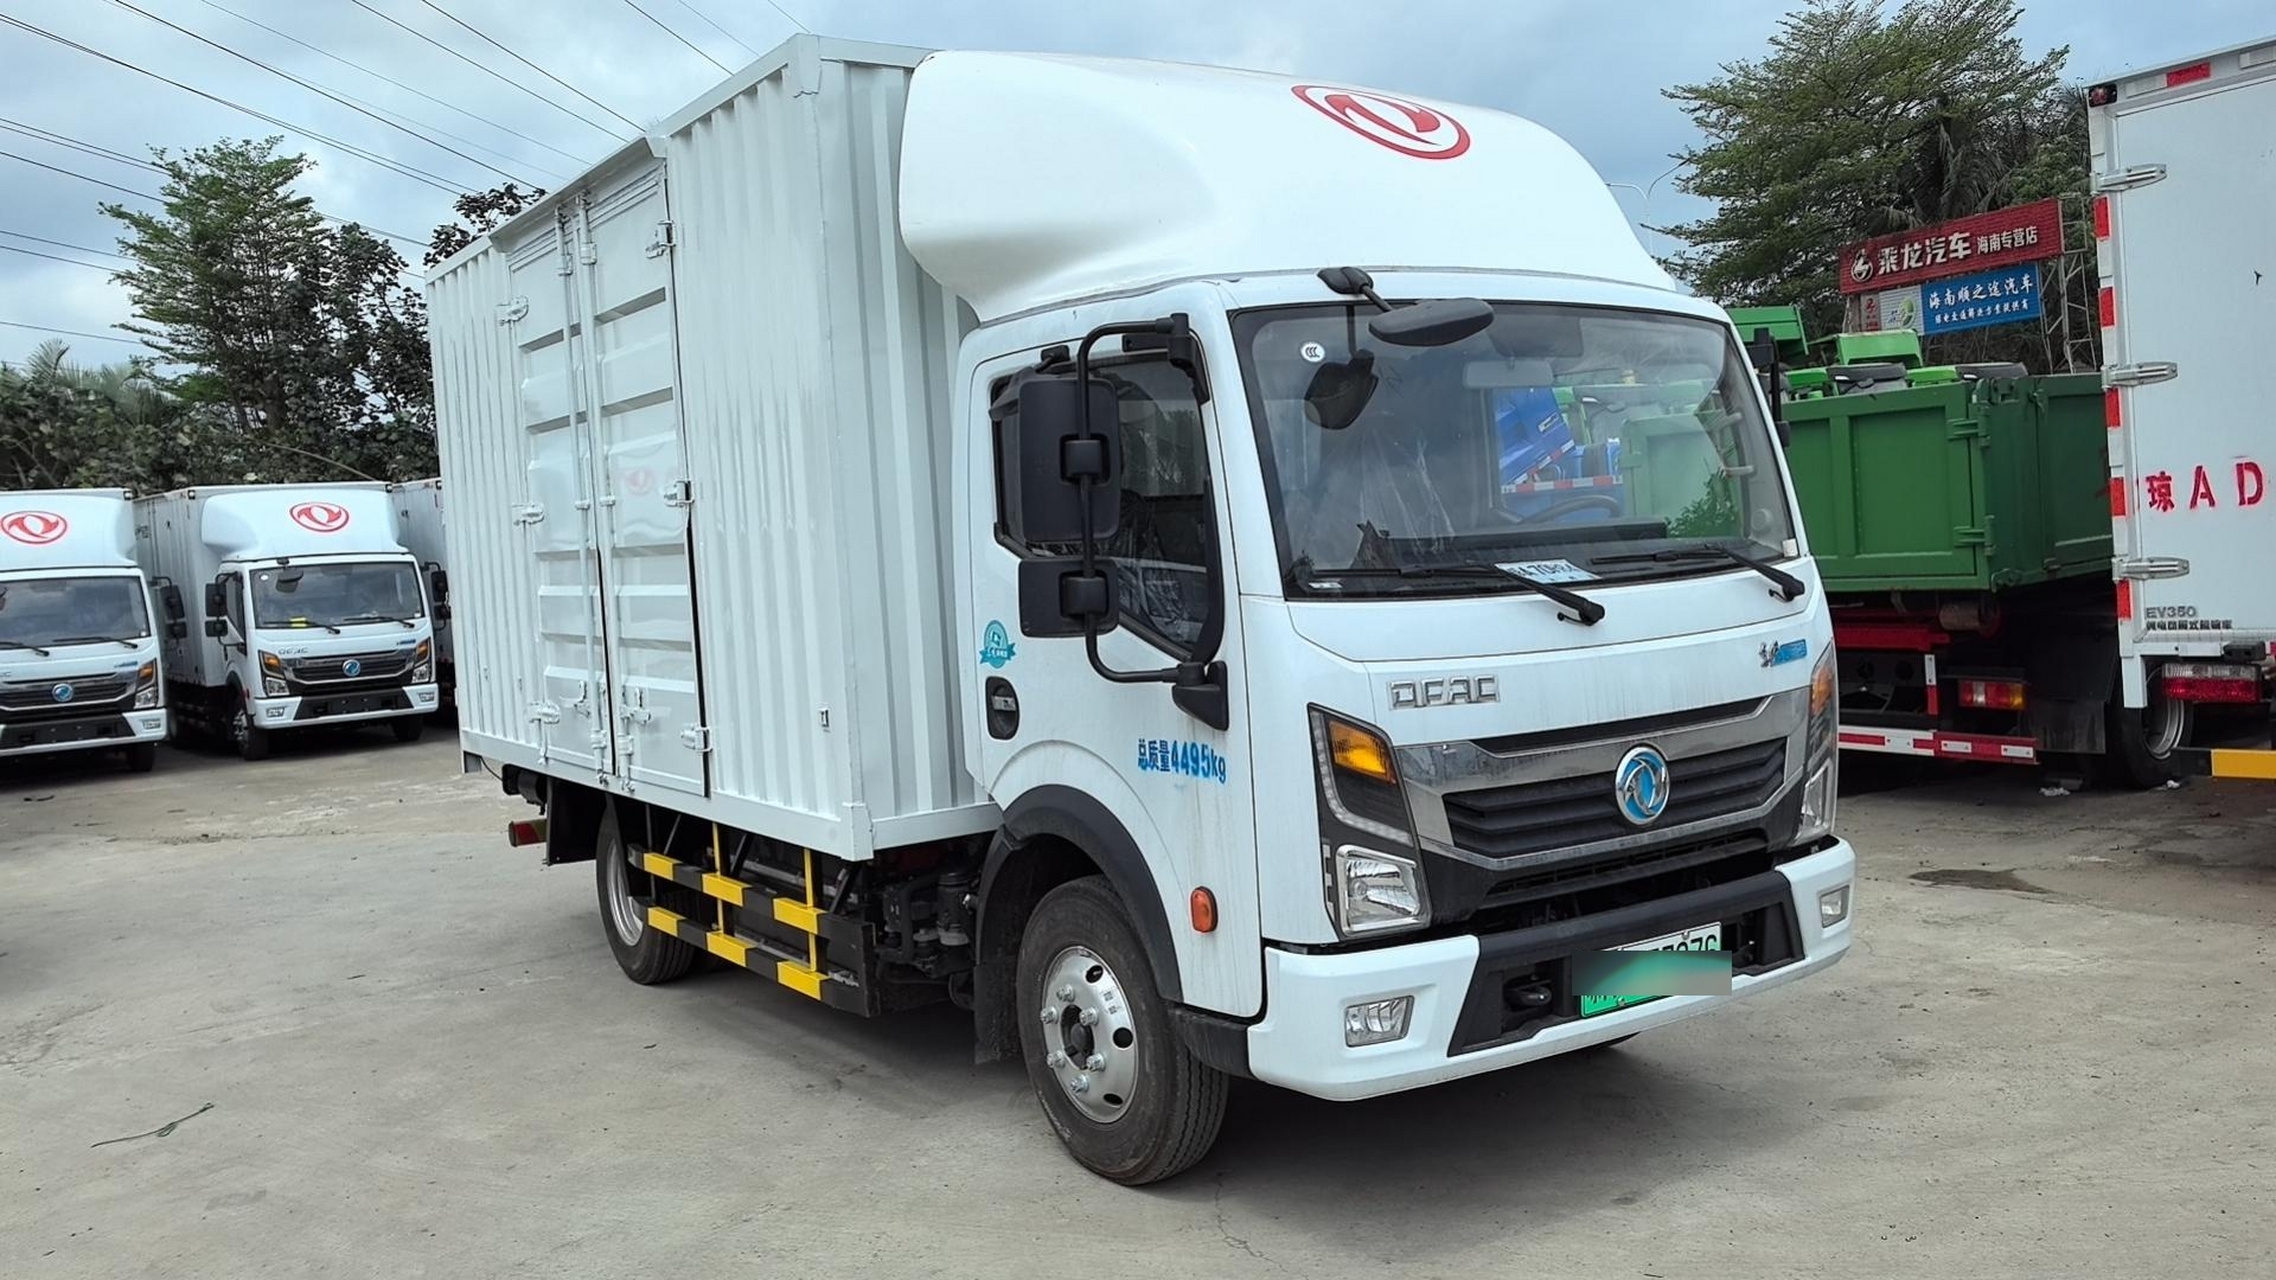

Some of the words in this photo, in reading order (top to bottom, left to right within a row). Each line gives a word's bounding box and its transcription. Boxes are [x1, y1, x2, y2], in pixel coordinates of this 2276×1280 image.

[1877, 231, 1971, 276] 乘龙汽车
[1976, 225, 2039, 255] 海南专营店
[2145, 606, 2197, 619] EV350
[1387, 675, 1500, 710] DFAC
[1137, 739, 1227, 784] 总质量4495kg
